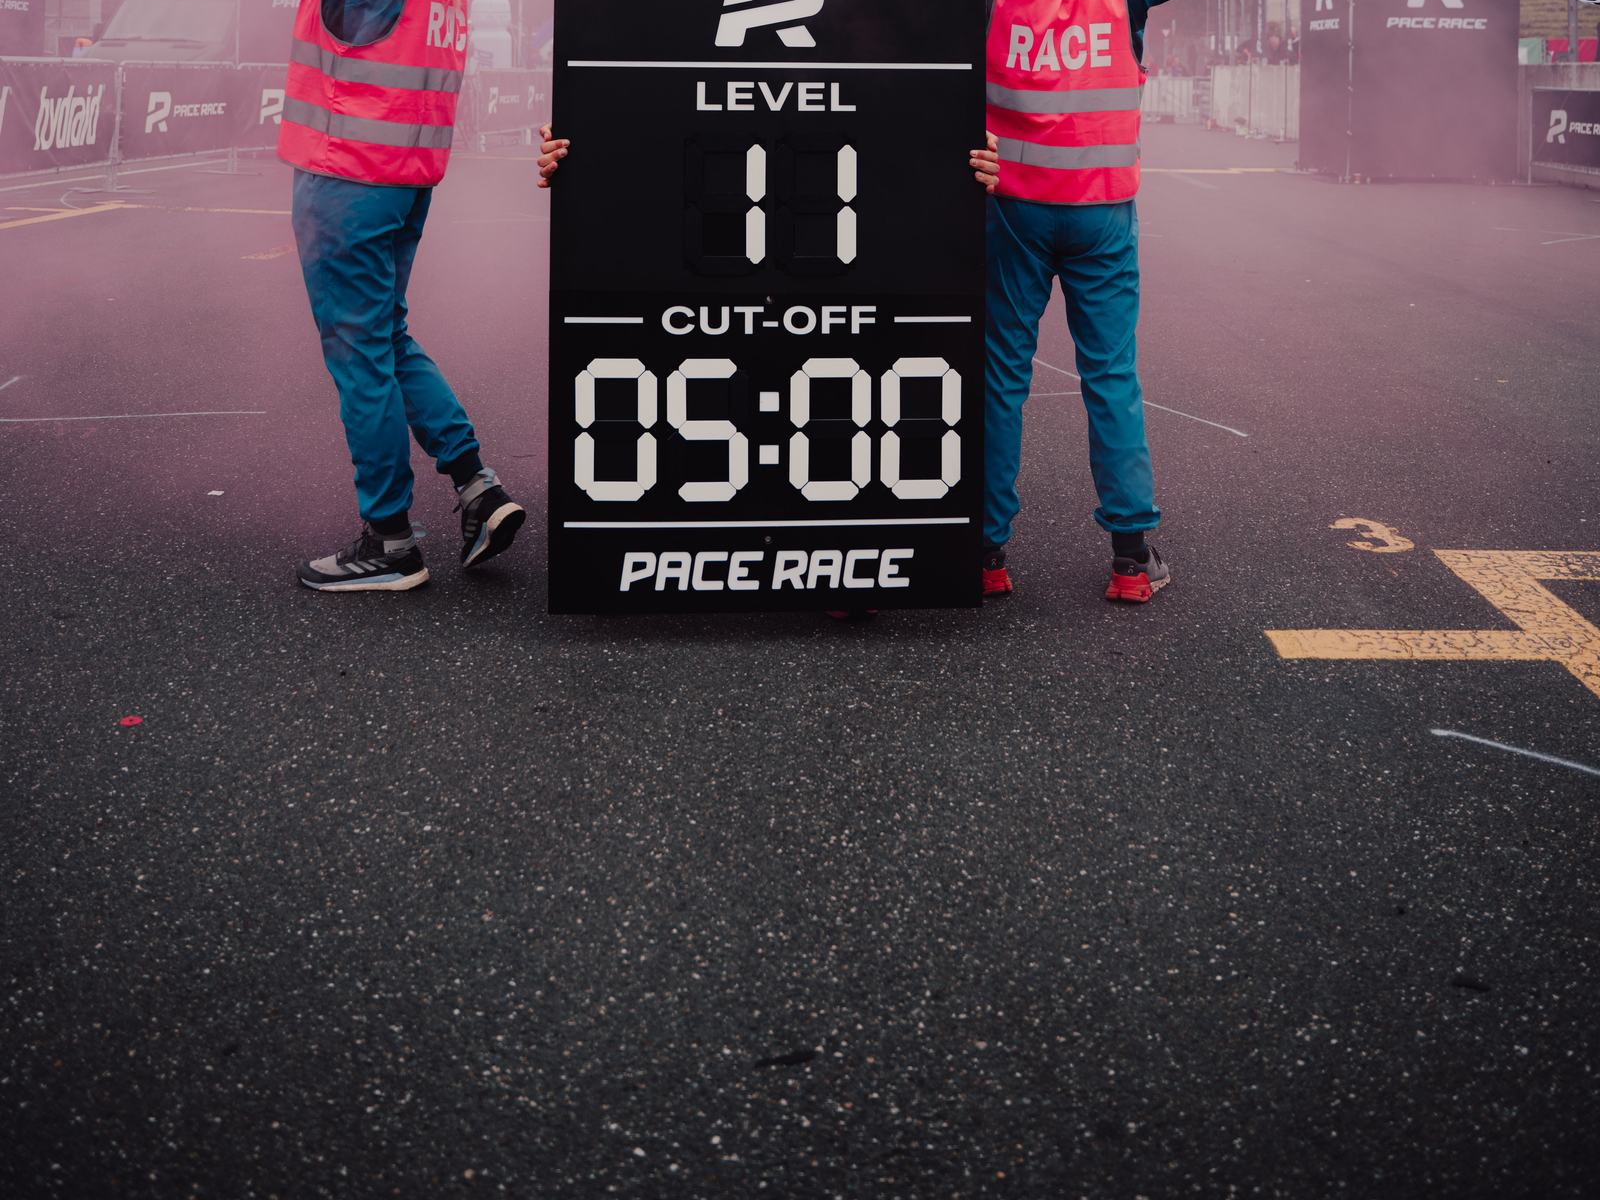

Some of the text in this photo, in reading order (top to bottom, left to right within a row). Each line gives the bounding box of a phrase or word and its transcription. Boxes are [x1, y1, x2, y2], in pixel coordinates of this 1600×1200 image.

[1386, 16, 1488, 30] PACE RACE
[1006, 22, 1112, 72] RACE
[173, 104, 201, 118] PACE
[201, 102, 227, 116] RACE
[696, 81, 857, 112] LEVEL
[1569, 121, 1593, 135] PACE
[745, 143, 857, 265] 11
[661, 305, 877, 336] CUT-OFF
[574, 356, 962, 502] 05:00
[619, 548, 915, 592] PACE RACE
